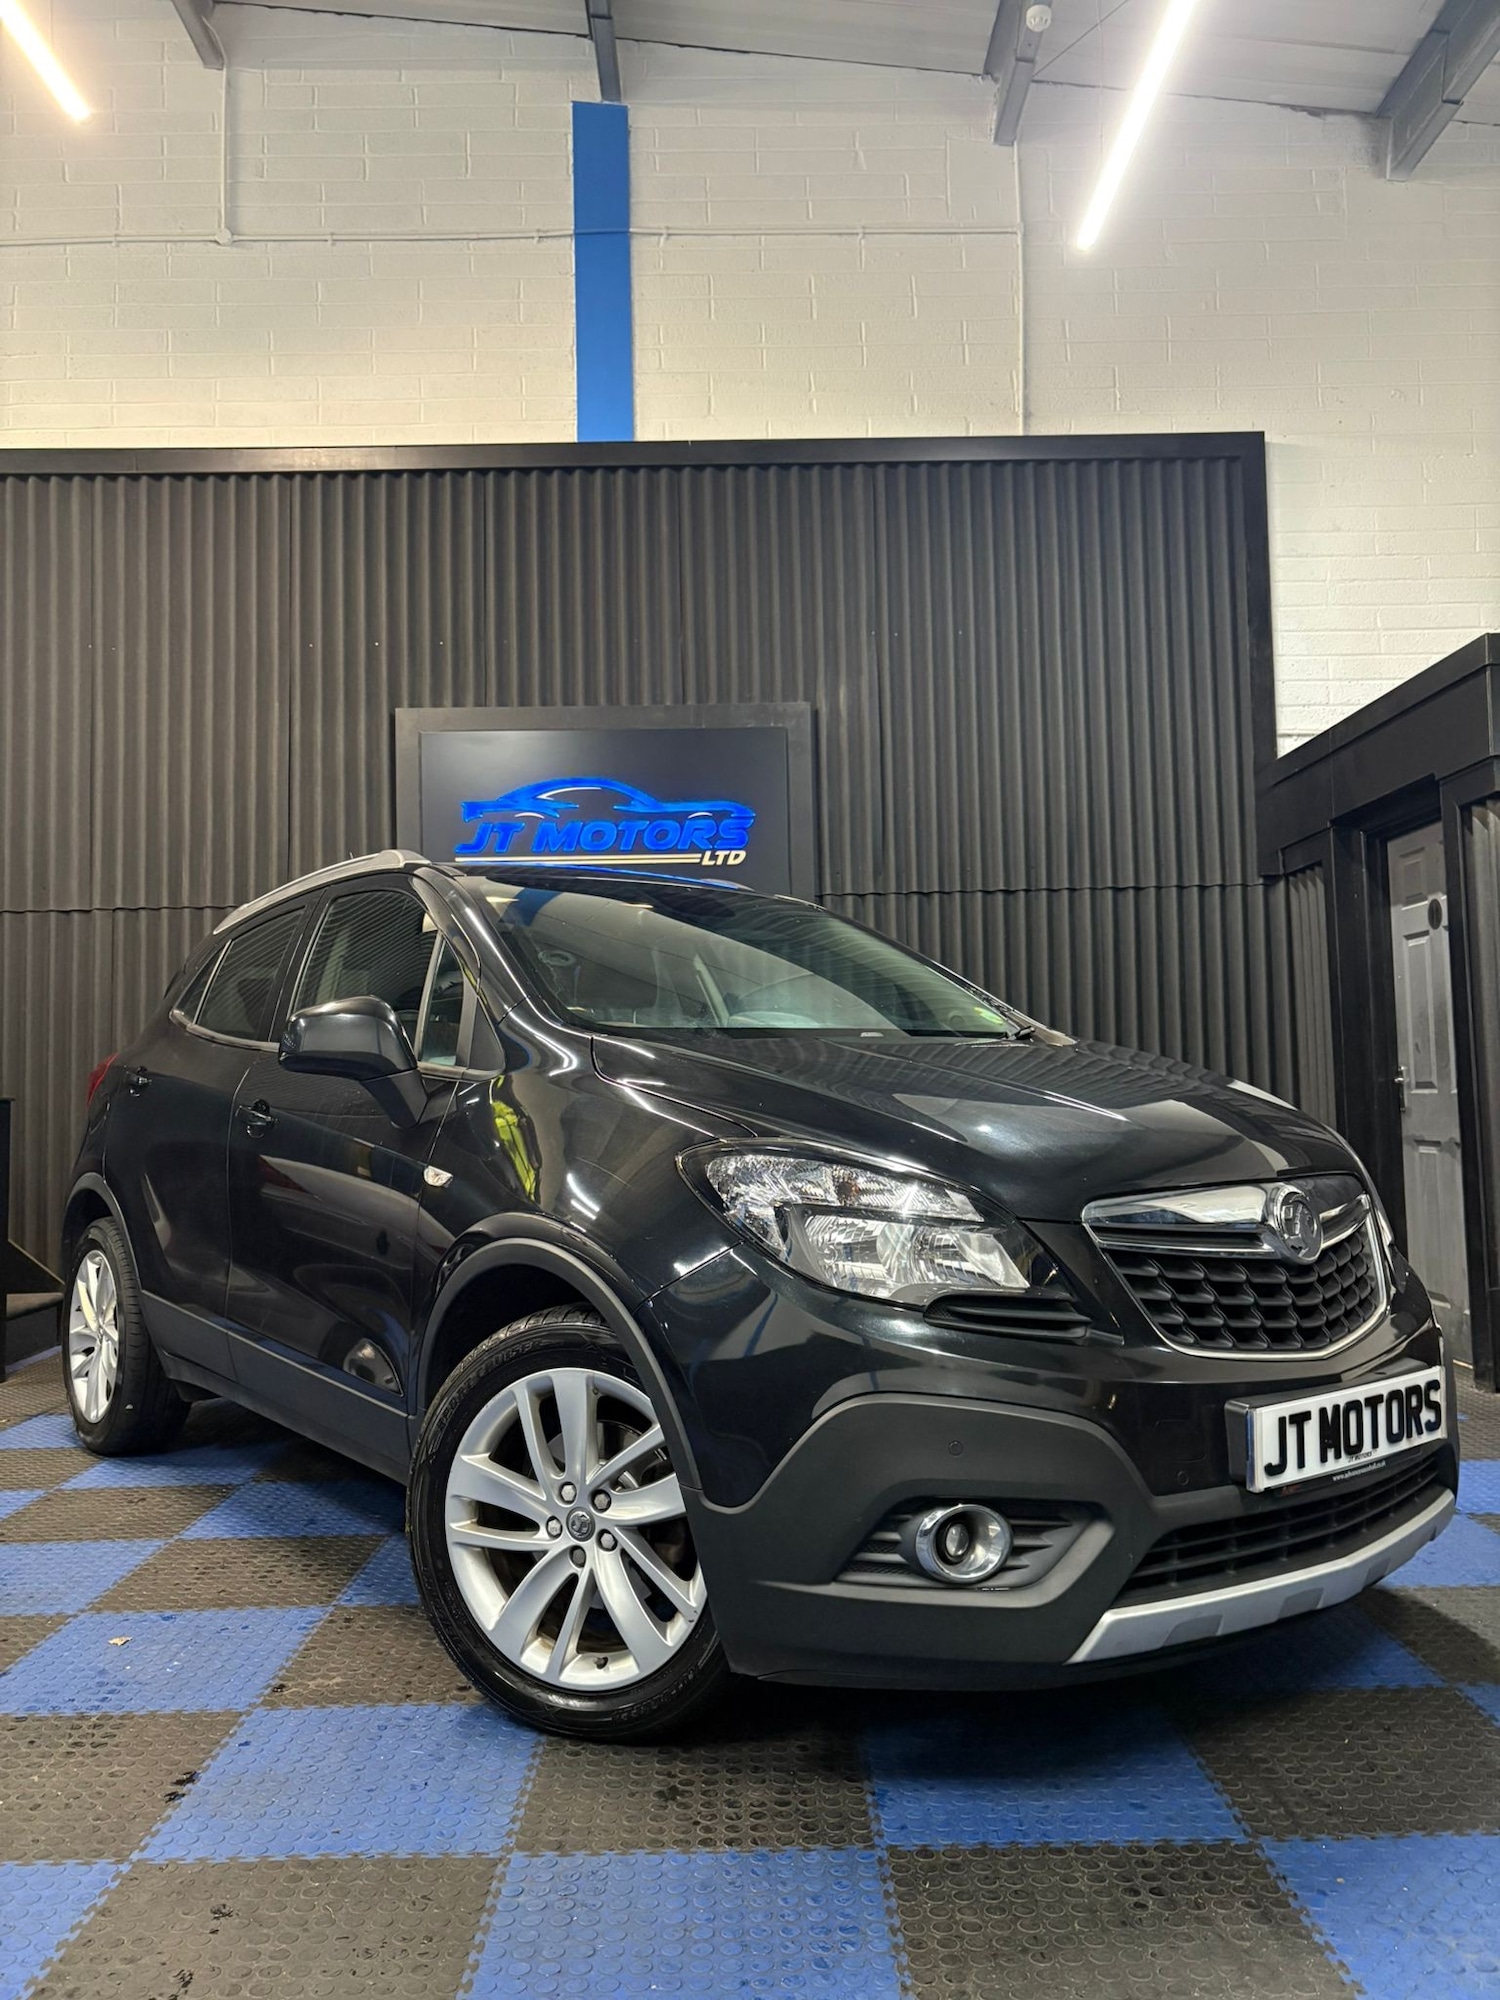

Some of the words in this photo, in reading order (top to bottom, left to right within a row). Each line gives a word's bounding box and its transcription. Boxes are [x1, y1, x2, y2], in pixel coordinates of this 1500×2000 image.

[454, 821, 525, 853] JT
[531, 818, 755, 853] MOTORS
[701, 850, 747, 866] LTD
[1264, 1410, 1311, 1477] JT
[1319, 1379, 1442, 1464] MOTORS
